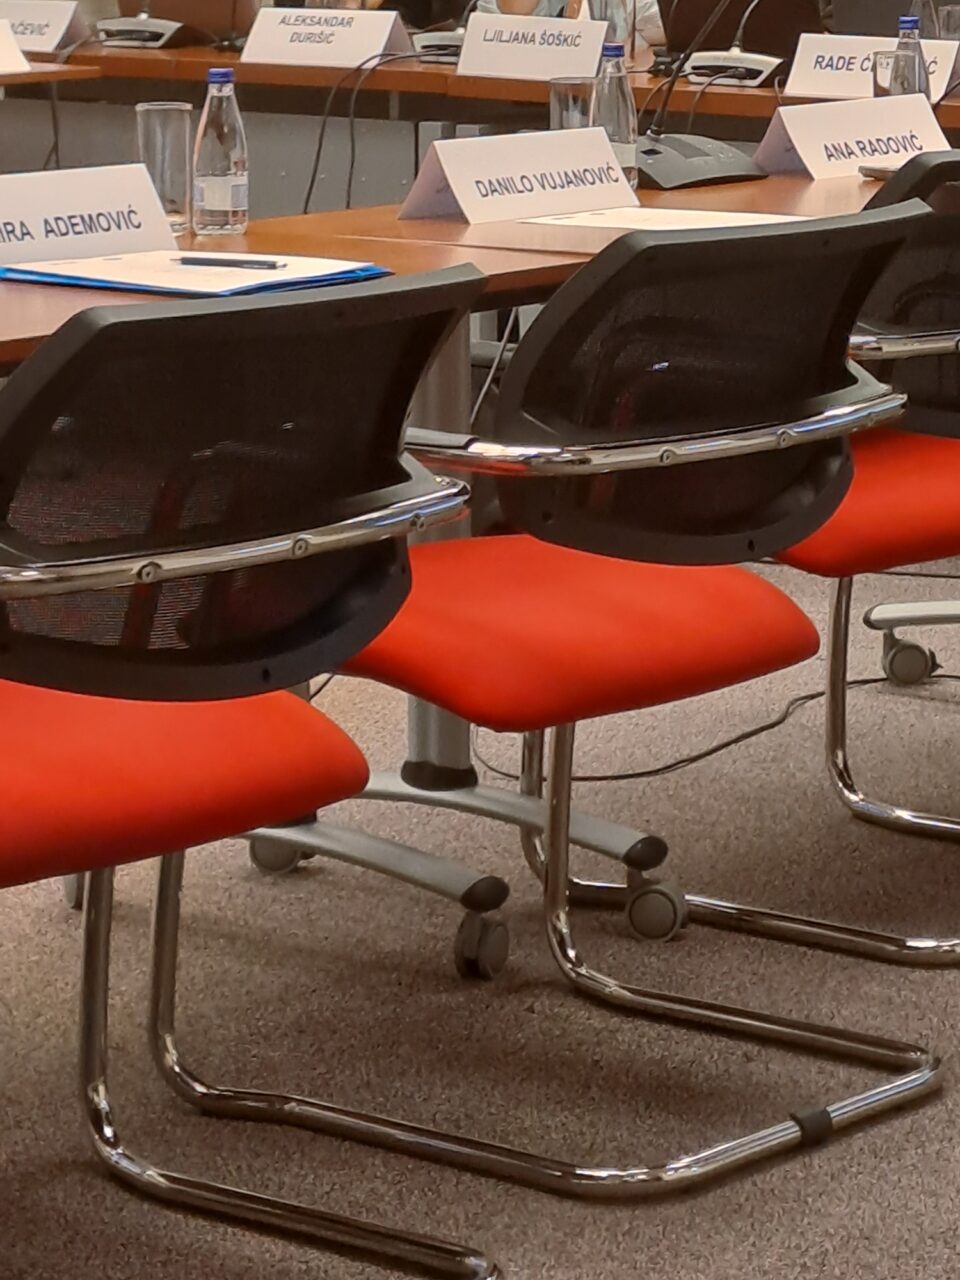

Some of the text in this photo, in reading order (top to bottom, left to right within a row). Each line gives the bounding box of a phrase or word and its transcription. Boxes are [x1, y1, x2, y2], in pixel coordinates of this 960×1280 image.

[279, 15, 354, 28] ALEKSANDAR
[538, 29, 582, 47] ŠOŠKIĆ
[814, 55, 857, 71] RADE
[823, 130, 924, 162] ANA RADOVIĆ
[474, 162, 620, 198] DANILO VUJANOVIĆ
[44, 204, 142, 239] ADEMOVIĆ
